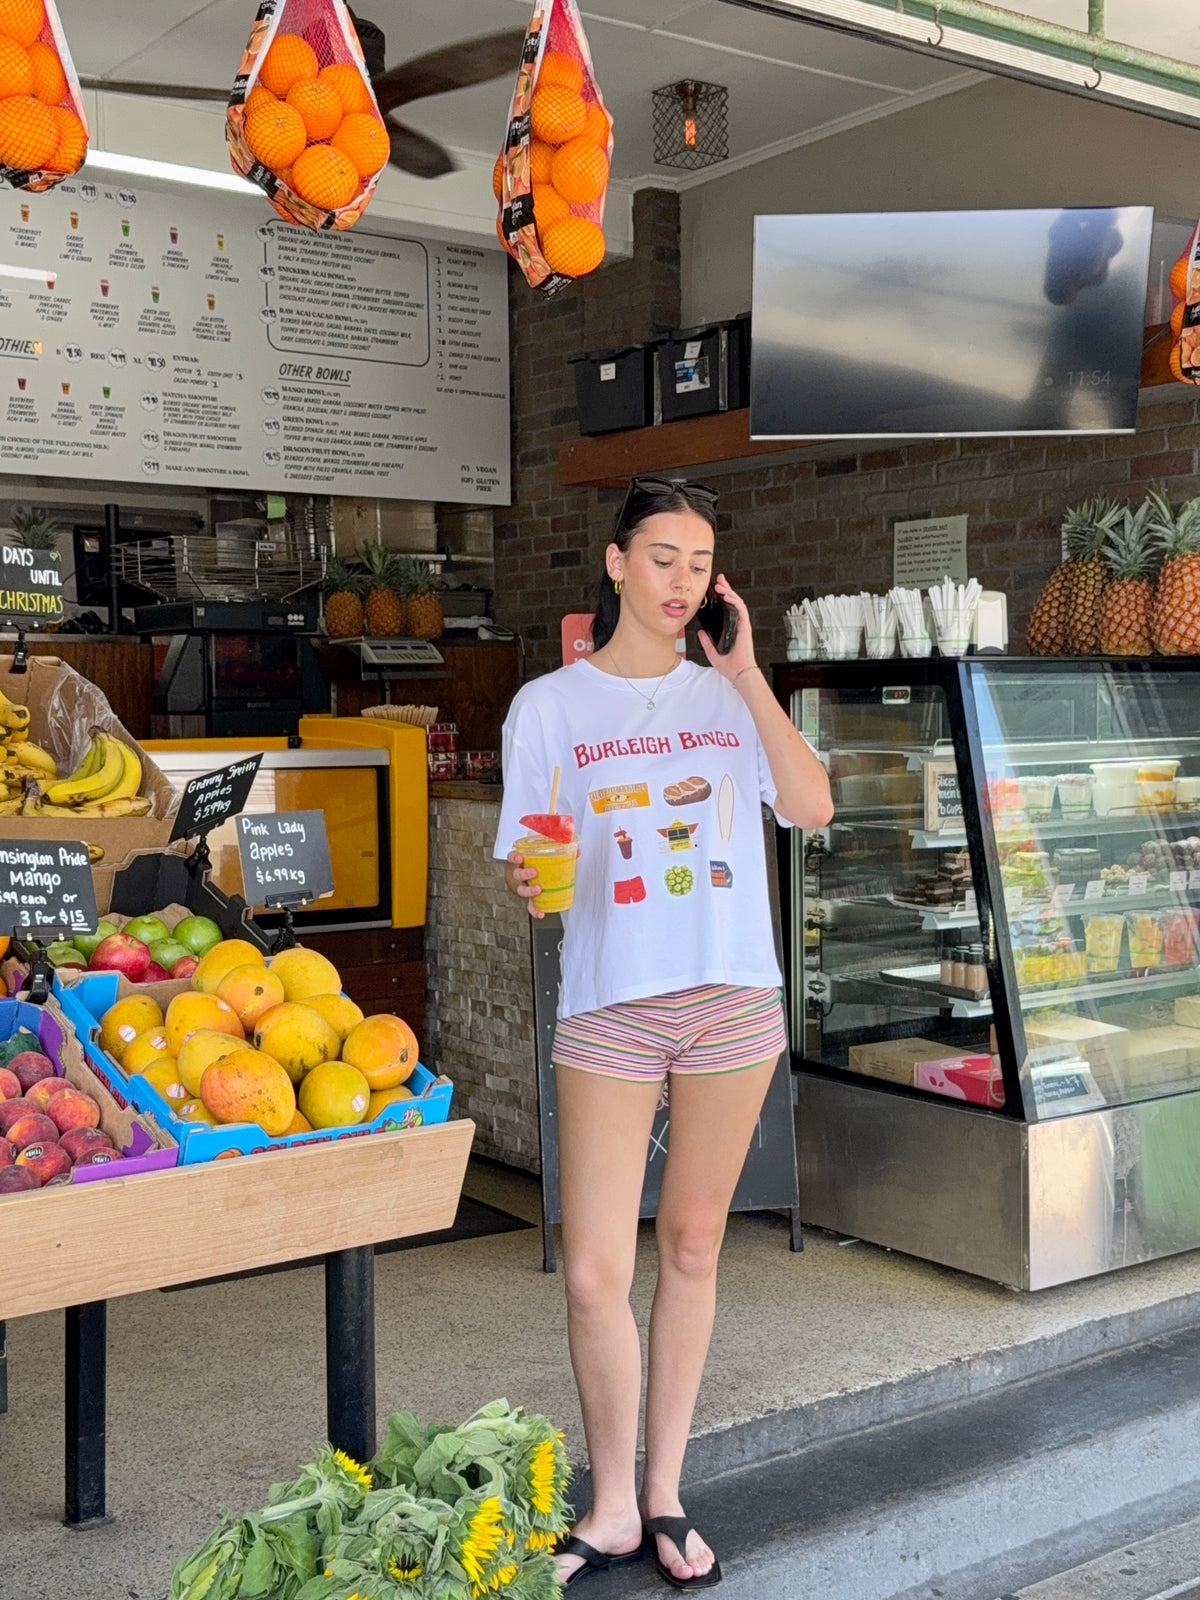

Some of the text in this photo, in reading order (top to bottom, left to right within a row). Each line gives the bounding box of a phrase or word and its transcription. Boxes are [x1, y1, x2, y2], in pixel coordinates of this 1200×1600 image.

[61, 186, 76, 194] REG
[277, 226, 306, 236] NUTELLA
[328, 273, 346, 281] BOWL
[312, 312, 334, 320] CACAO
[335, 314, 352, 322] BOWL
[279, 363, 352, 382] OTHER BOWLS
[1066, 370, 1112, 386] 11:54
[282, 386, 325, 396] MANGO BOWL
[56, 440, 92, 449] FOLLOWING
[283, 445, 310, 453] DRAGON
[3, 546, 34, 566] DAYS
[30, 570, 62, 586] UNTIL
[0, 590, 63, 614] CHRISTMAS
[573, 731, 740, 768] BURLEIGH BINGO
[188, 761, 257, 793] Granny Smith
[242, 818, 306, 842] Pink Lady
[59, 847, 88, 866] Pride
[250, 842, 293, 862] apples
[10, 871, 61, 894] Mango
[20, 895, 47, 905] each
[62, 894, 78, 903] or
[20, 908, 85, 926] 3 for $15
